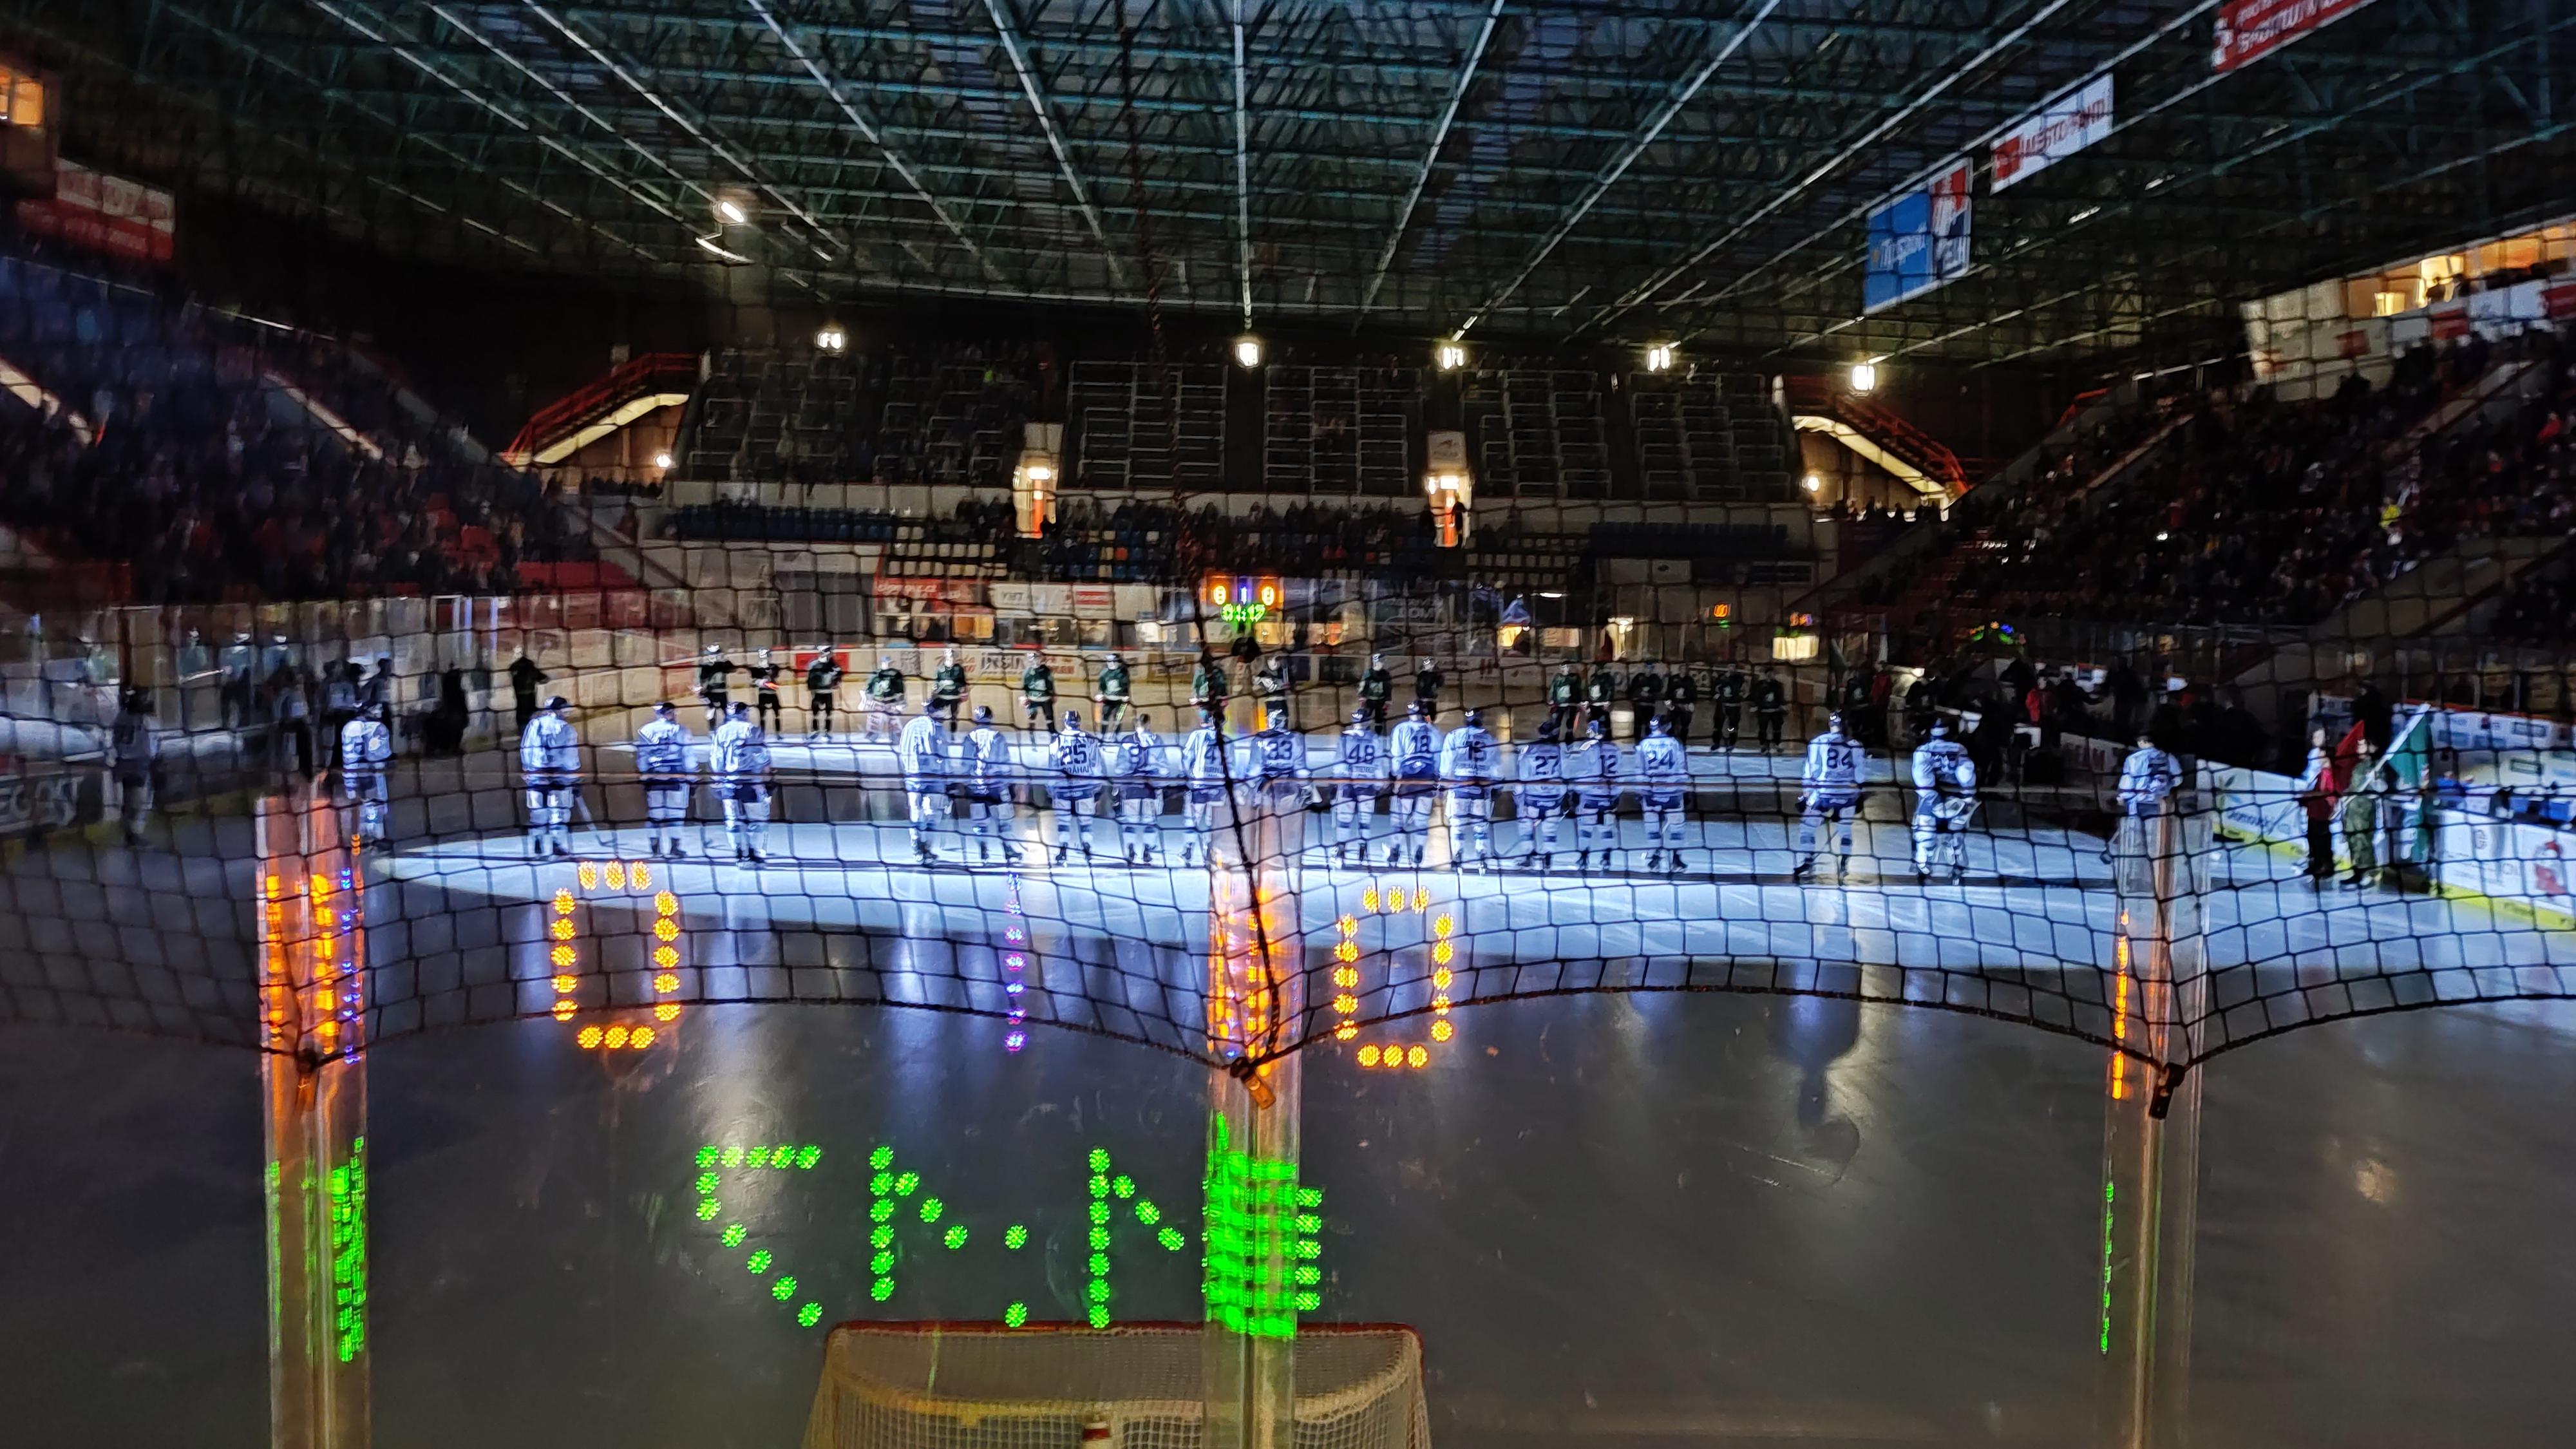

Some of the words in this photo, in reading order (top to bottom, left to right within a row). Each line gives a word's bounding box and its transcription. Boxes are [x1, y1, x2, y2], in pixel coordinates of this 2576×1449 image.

[1061, 744, 1087, 765] 25
[1348, 743, 1374, 765] 48
[1535, 754, 1559, 775] 27
[1647, 749, 1675, 770] 24
[1827, 748, 1853, 768] 84
